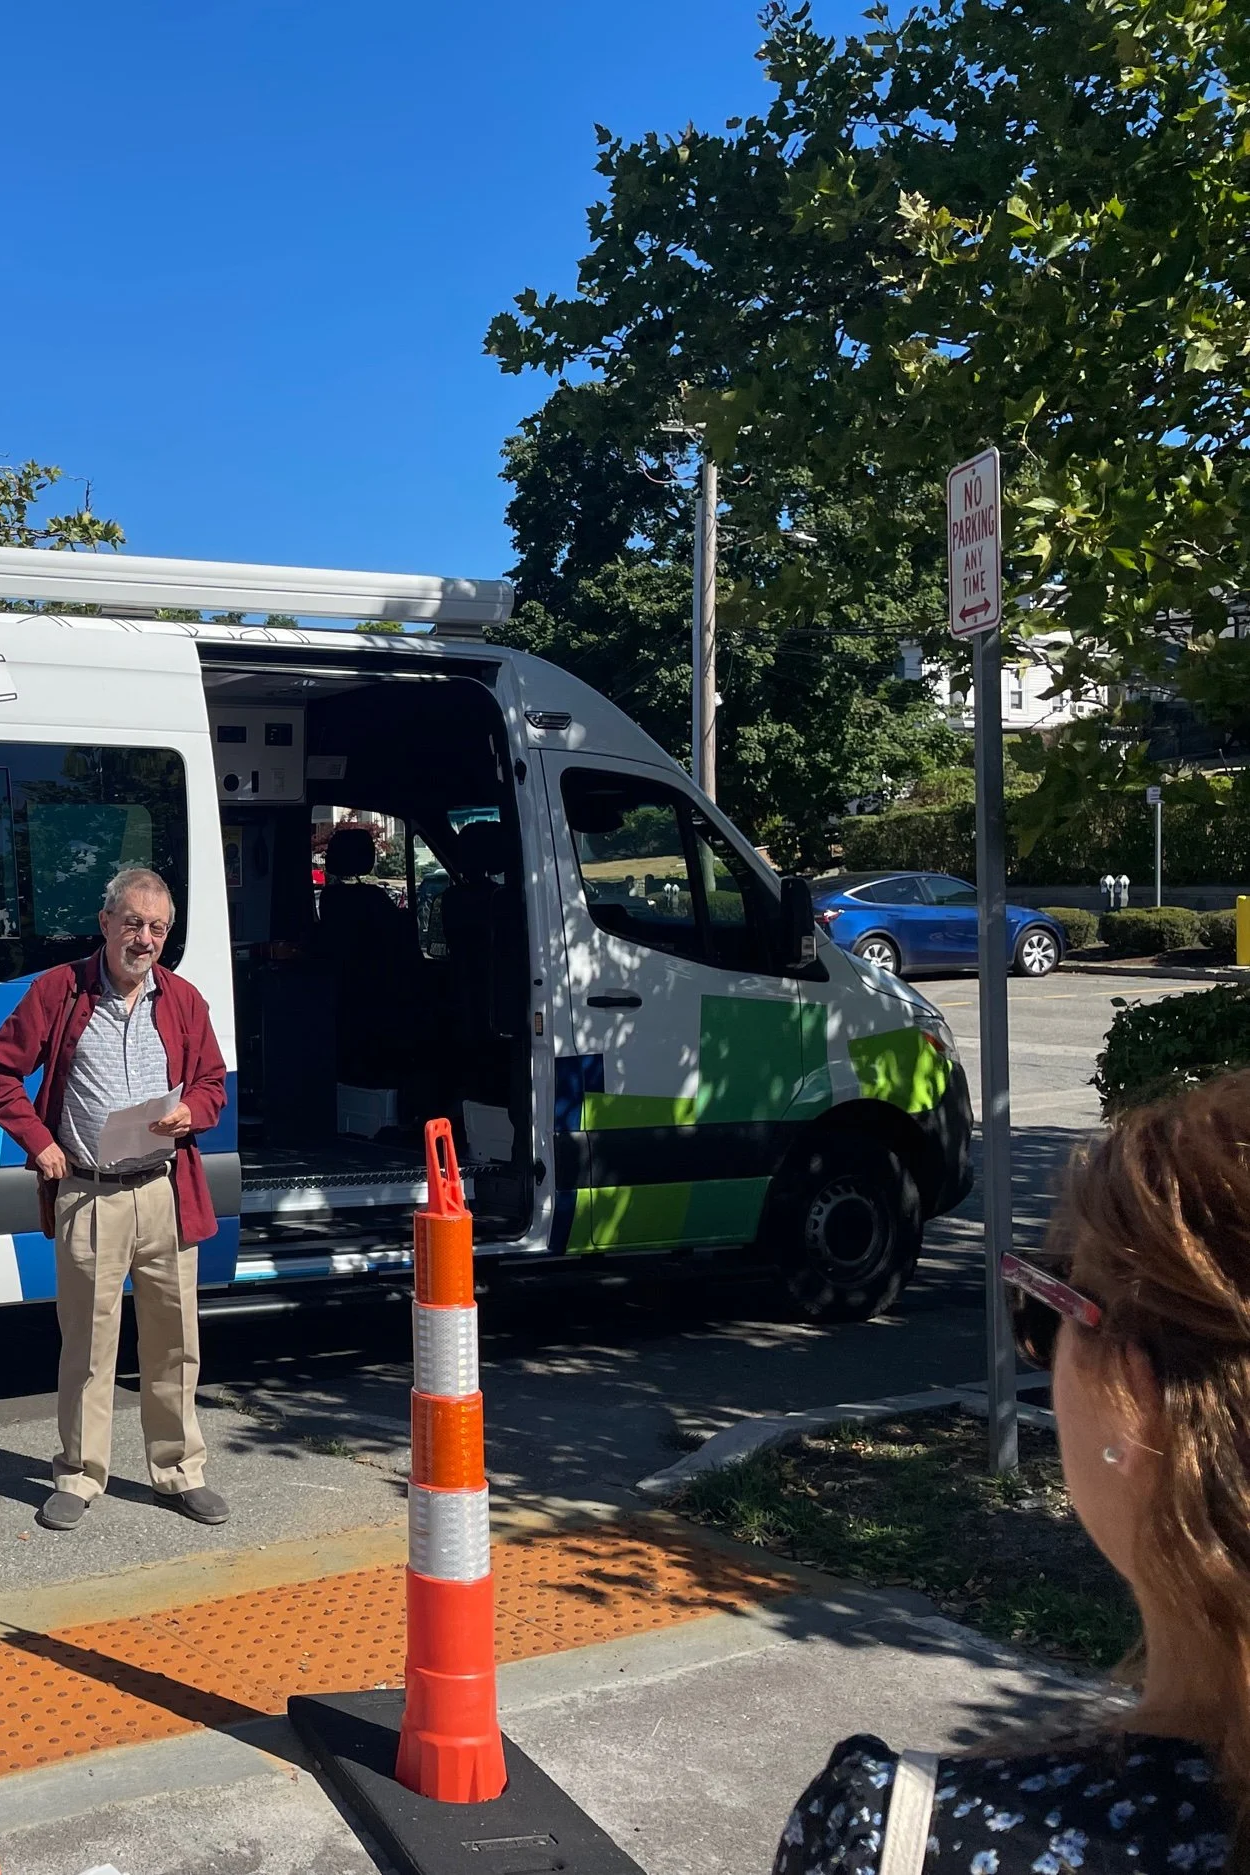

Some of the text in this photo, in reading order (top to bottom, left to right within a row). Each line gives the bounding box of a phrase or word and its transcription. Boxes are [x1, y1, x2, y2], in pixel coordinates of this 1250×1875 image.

[964, 476, 982, 512] NO
[953, 505, 994, 552] PARKING
[965, 546, 984, 573] ANY
[963, 570, 986, 598] TIME
